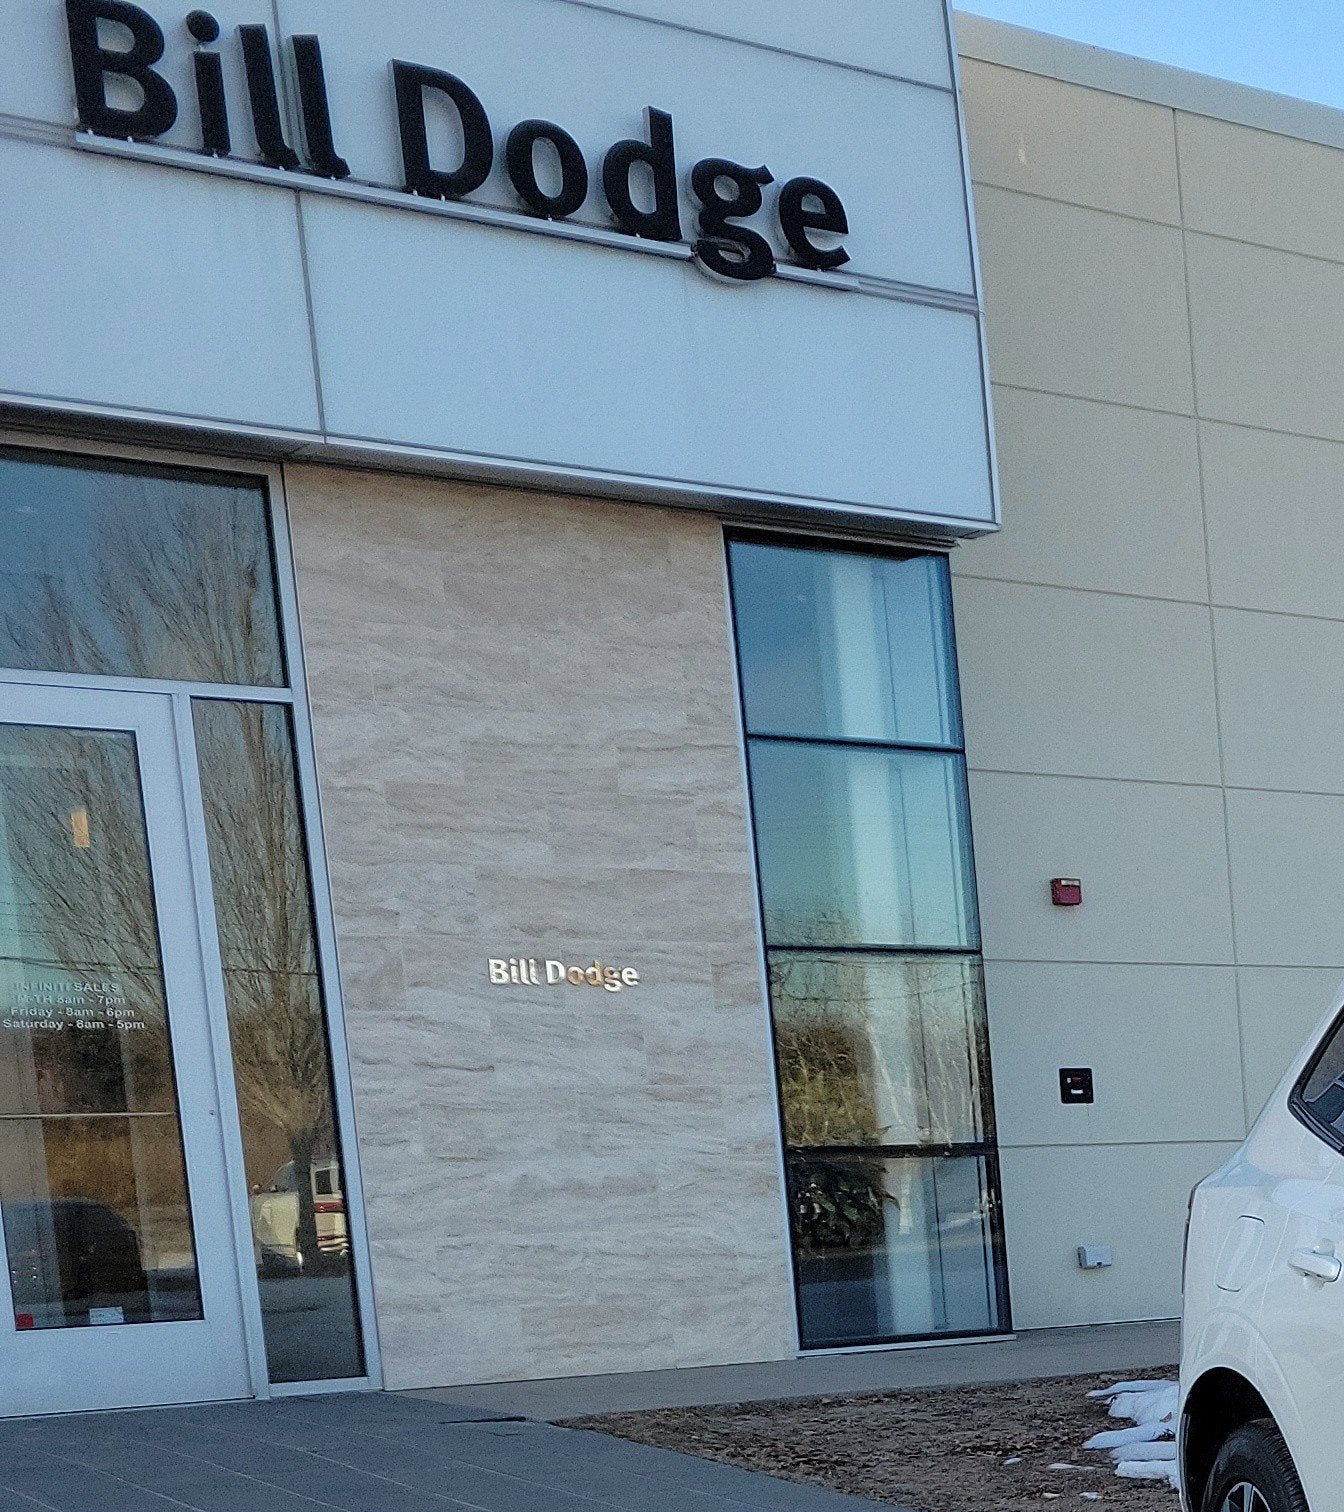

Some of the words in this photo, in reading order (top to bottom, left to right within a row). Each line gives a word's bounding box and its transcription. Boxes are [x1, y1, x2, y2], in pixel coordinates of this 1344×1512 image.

[66, 0, 351, 180] Bill
[388, 57, 851, 281] Dodge
[488, 957, 540, 986] Bill
[545, 959, 641, 993] Dodge
[73, 982, 121, 993] SALES
[11, 1007, 53, 1018] Friday
[65, 1007, 95, 1017] 8am
[105, 1007, 135, 1019] 6pm
[2, 1018, 64, 1031] Saturday
[116, 1020, 146, 1031] 5pm
